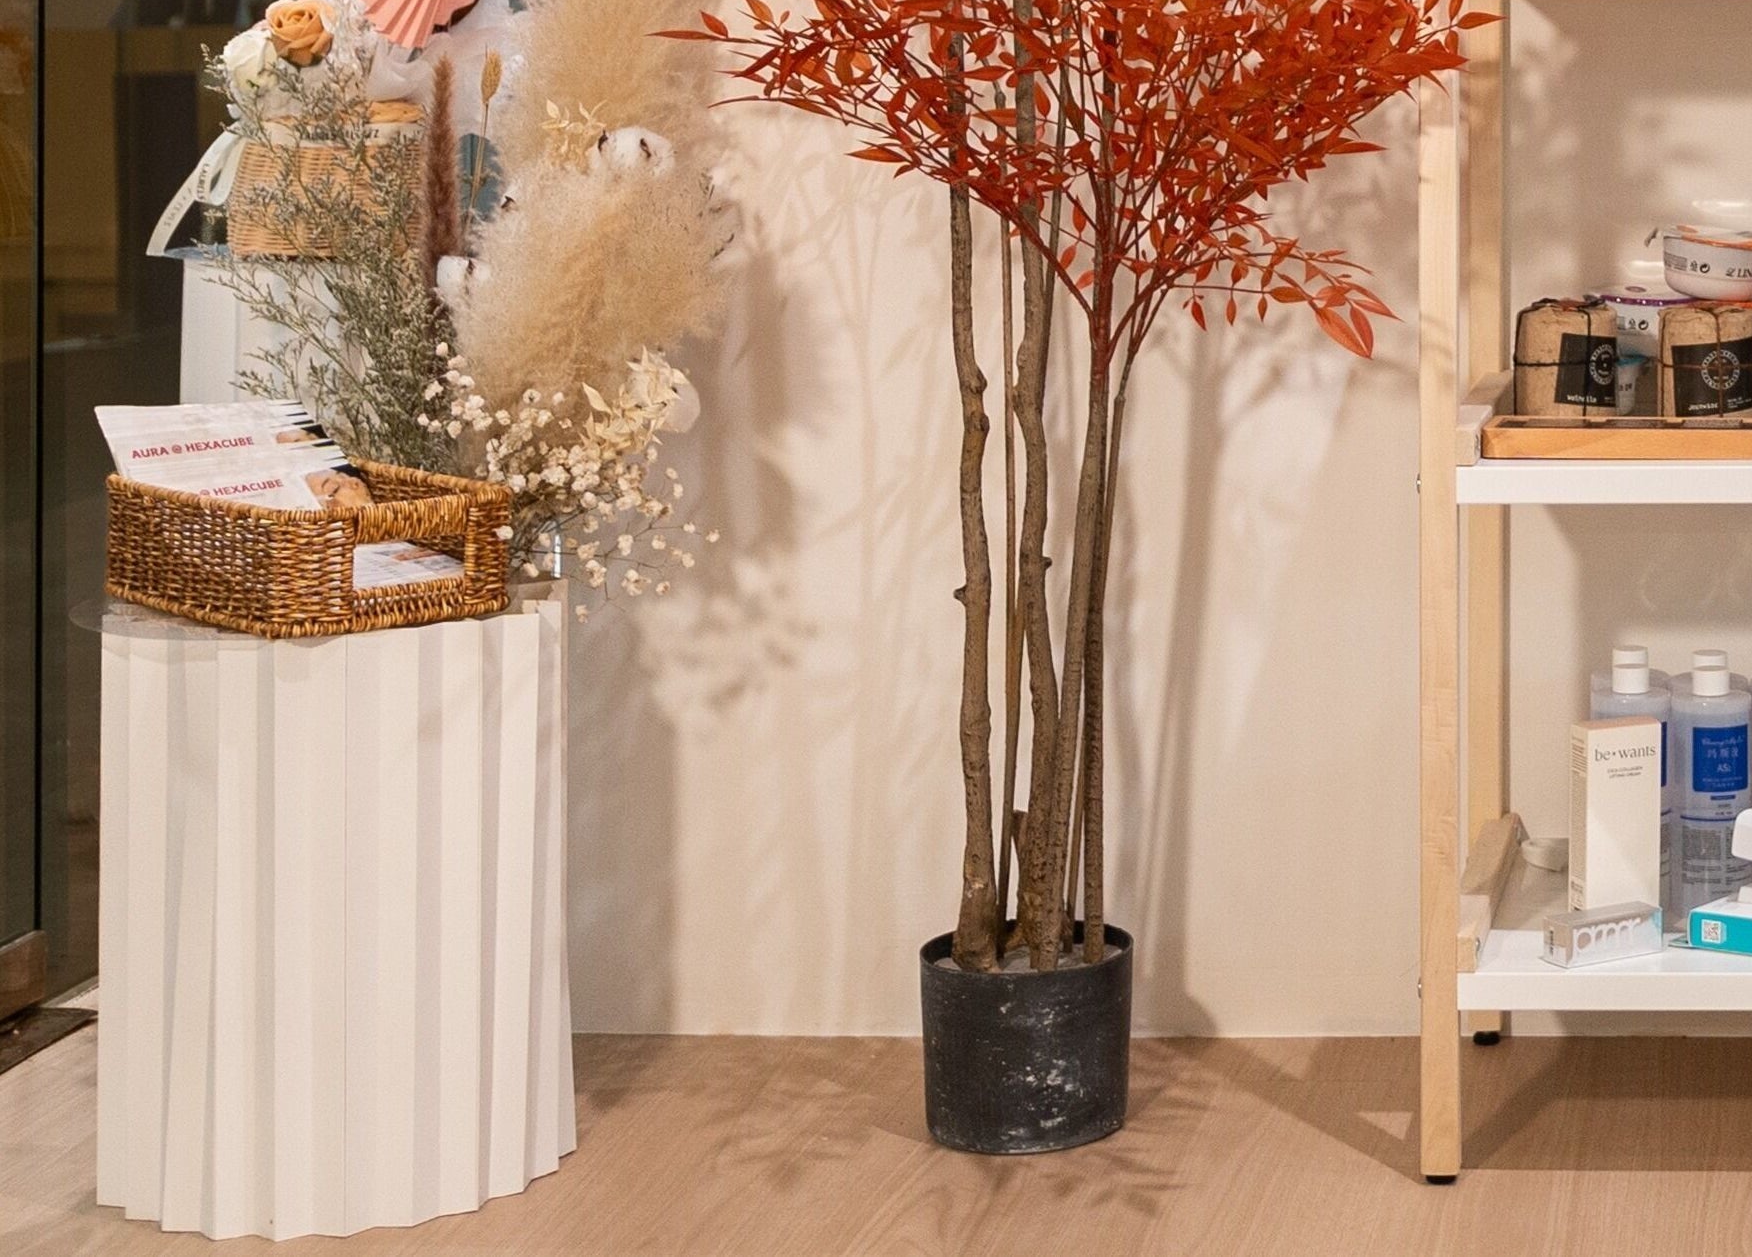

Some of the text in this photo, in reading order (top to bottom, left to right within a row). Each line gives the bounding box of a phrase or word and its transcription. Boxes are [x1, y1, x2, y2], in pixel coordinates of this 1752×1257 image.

[132, 436, 254, 459] AURA @ HEXACUBE
[213, 479, 284, 497] HEXACUBE
